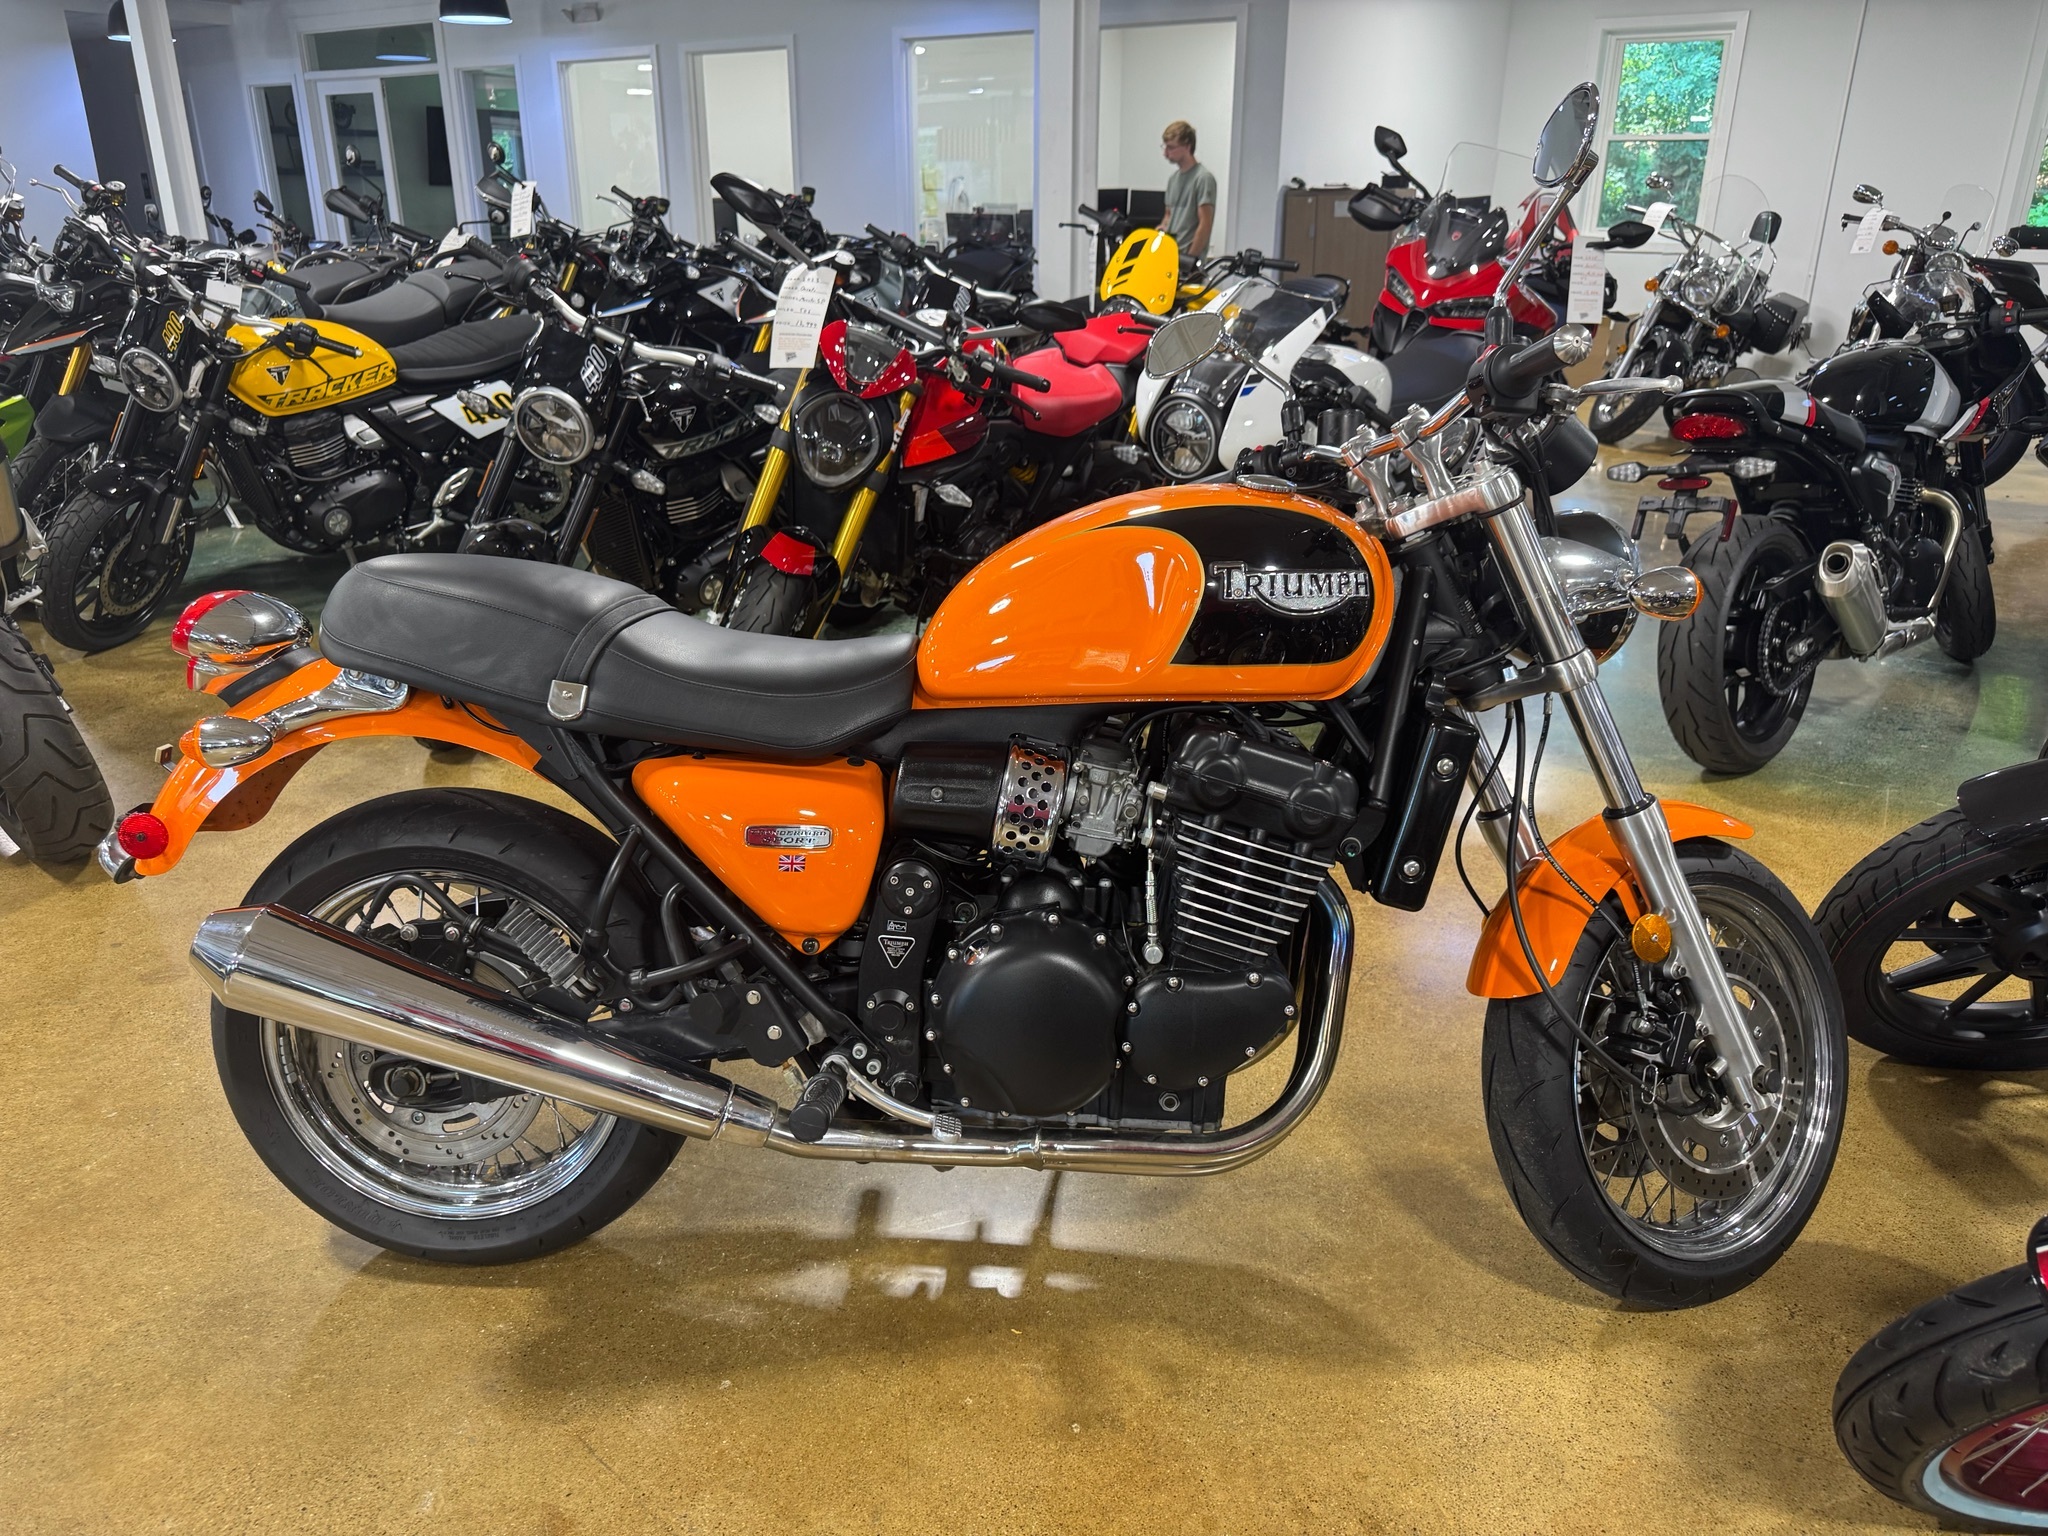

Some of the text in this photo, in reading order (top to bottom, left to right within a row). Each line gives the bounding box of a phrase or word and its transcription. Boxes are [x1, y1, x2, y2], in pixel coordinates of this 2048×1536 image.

[162, 311, 184, 352] 400
[265, 363, 394, 409] TRACKER
[1213, 562, 1370, 602] TRIUMPH
[762, 836, 816, 845] SPORT
[883, 938, 909, 947] TRIUMPH
